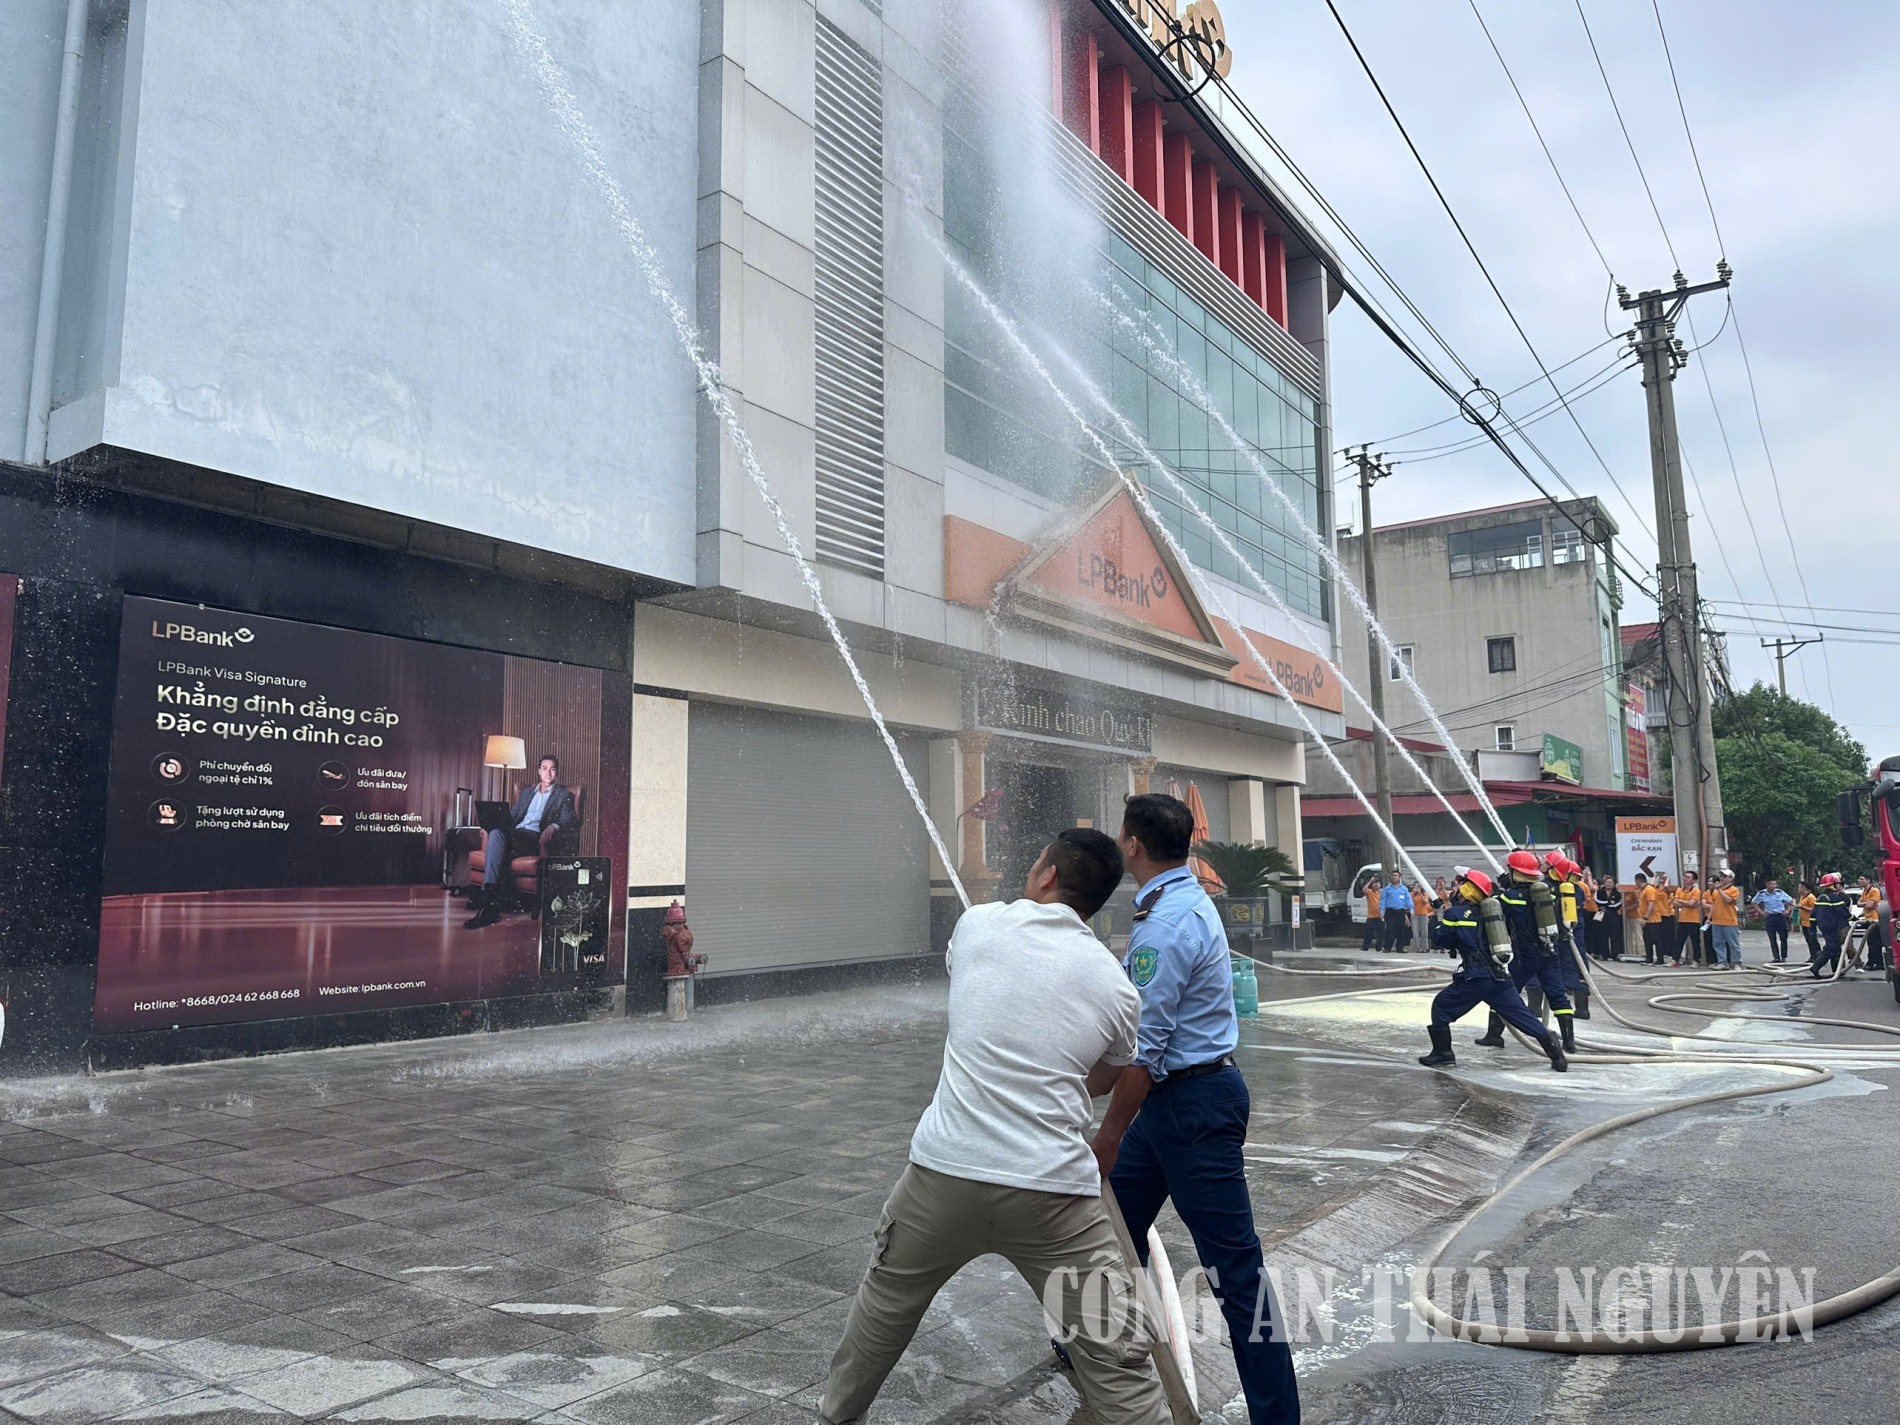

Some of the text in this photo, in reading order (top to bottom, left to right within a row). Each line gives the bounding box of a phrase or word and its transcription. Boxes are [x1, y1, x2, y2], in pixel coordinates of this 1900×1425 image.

[1078, 551, 1150, 608] LPBank
[152, 620, 234, 647] LPBank
[158, 660, 307, 688] LPBank Visa Signature
[157, 681, 399, 728] Khẳng định đẳng cấp
[156, 712, 383, 747] Đặc quyền đỉnh cao
[200, 760, 216, 769] Phí
[217, 761, 254, 773] chuyển
[357, 767, 407, 779] Ưu đãi đưa/
[199, 774, 273, 785] ngoại tệ chỉ 1%
[357, 780, 408, 791] đón sân bay
[196, 805, 221, 816] Tặng
[223, 806, 244, 817] lượt
[259, 808, 285, 818] dụng
[355, 812, 422, 822] Ưu đãi tích điểm
[195, 819, 290, 831] phòng chờ sân bay
[355, 824, 368, 832] chi
[369, 824, 386, 832] tiêu
[402, 825, 433, 835] thưởng
[1623, 822, 1659, 831] LPBank
[583, 954, 605, 964] VISA
[319, 980, 426, 996] Website: lpbank.com.vn
[133, 1001, 179, 1012] Hotline:
[244, 993, 258, 1002] 62
[259, 991, 279, 1001] 668
[280, 989, 300, 999] 668
